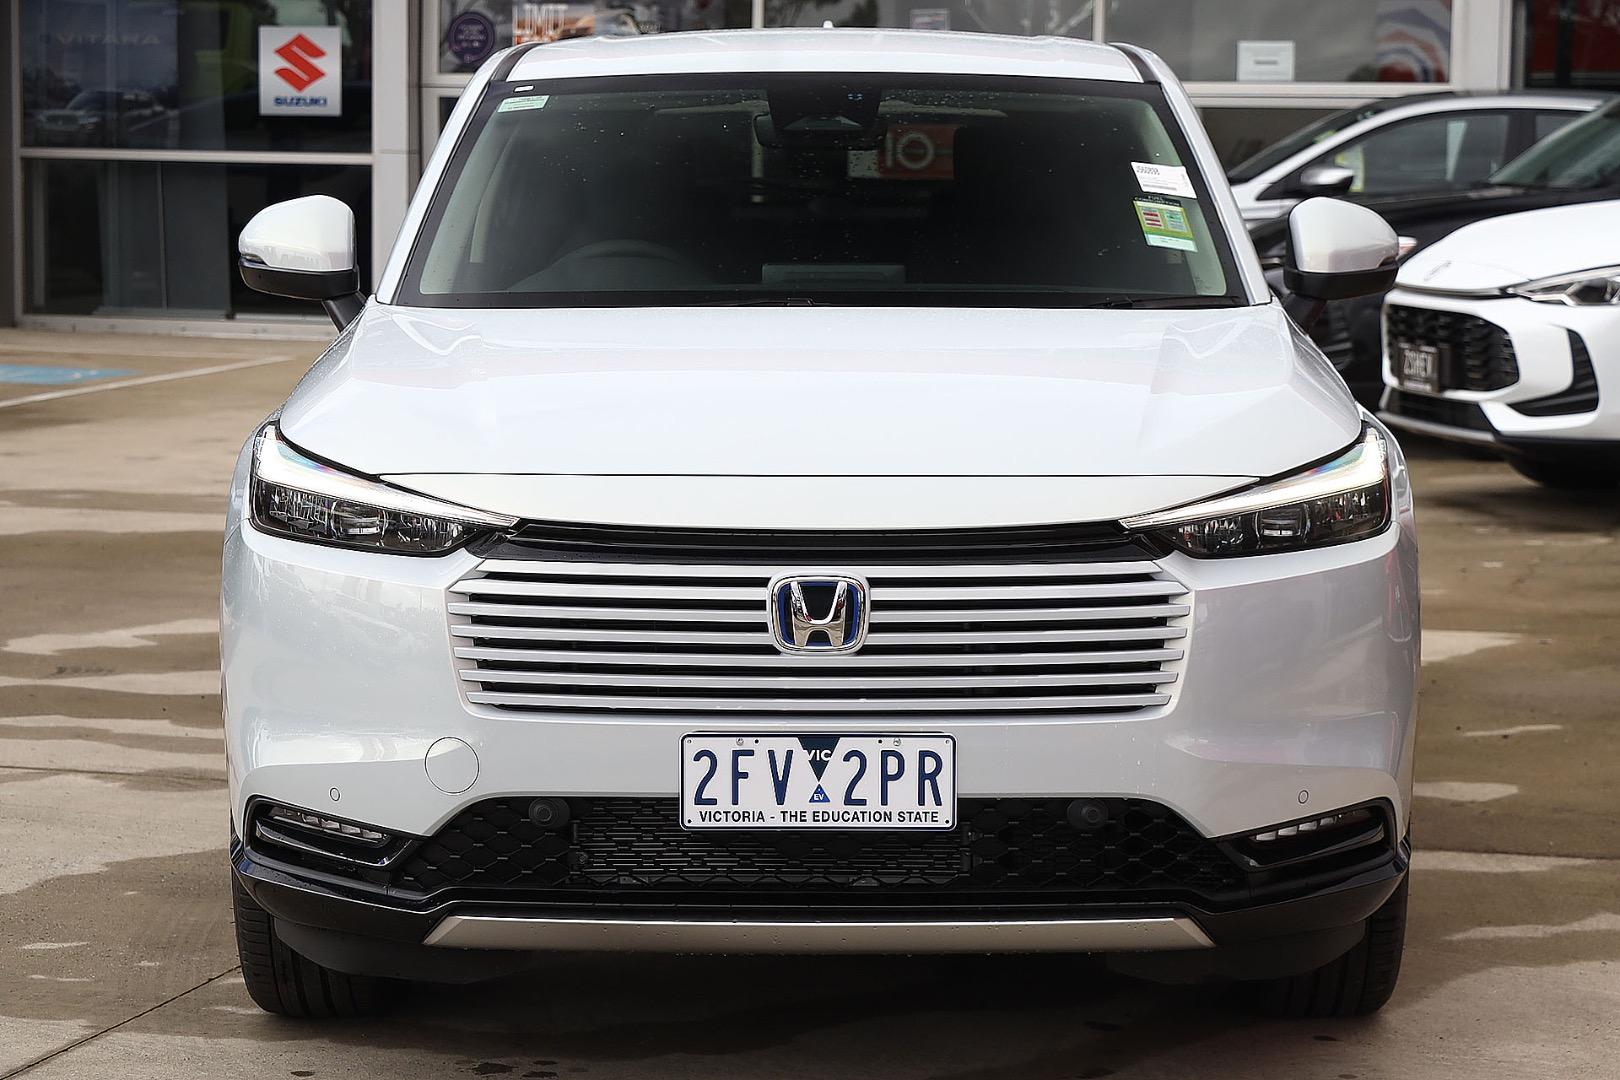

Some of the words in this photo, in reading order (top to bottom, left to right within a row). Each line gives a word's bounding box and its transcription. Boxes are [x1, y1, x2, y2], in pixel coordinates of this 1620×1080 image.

[806, 749, 832, 762] VIC
[693, 749, 794, 806] 2FV
[842, 749, 943, 807] 2PR
[813, 793, 825, 801] EV
[700, 810, 765, 823] VICTORIA
[780, 810, 807, 823] THE
[812, 810, 892, 823] EDUCATION
[897, 810, 939, 823] STATE
